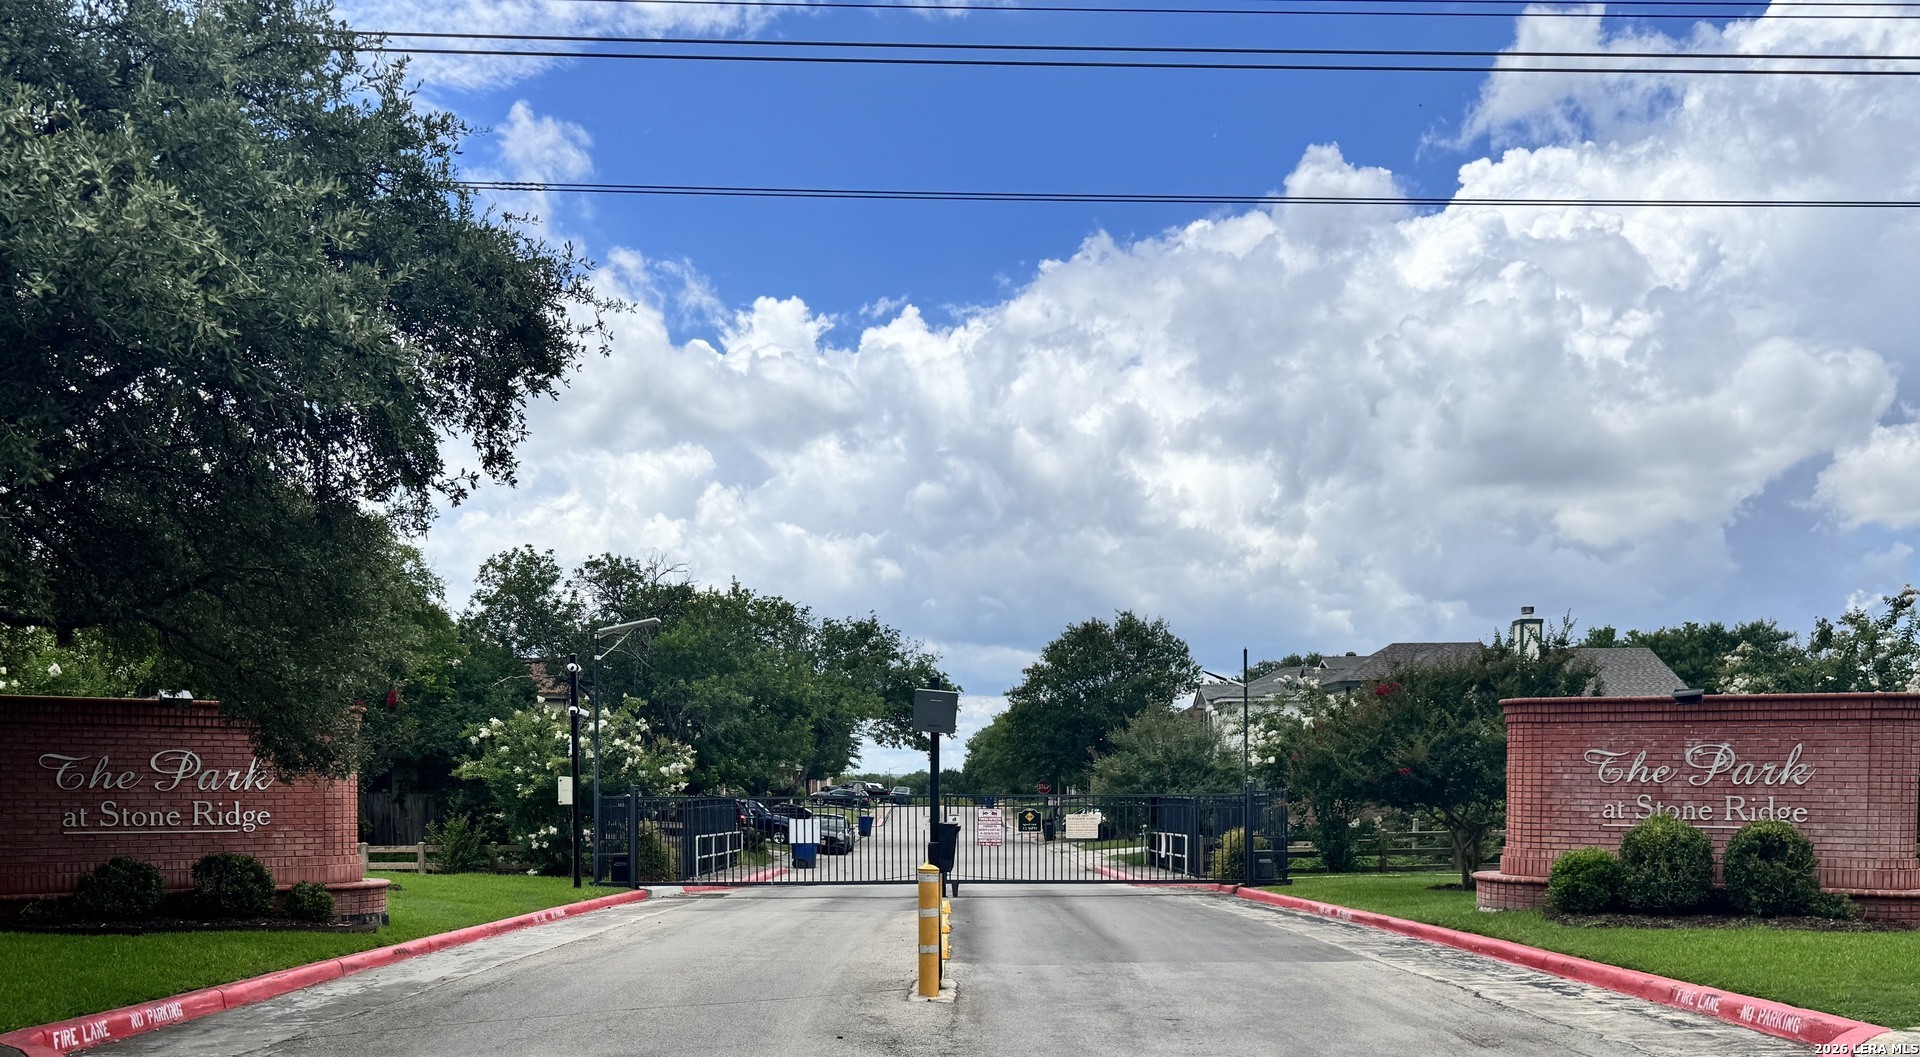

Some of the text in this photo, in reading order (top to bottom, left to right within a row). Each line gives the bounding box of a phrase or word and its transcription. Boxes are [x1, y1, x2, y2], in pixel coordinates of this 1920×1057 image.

[39, 749, 275, 792] The Park
[1584, 743, 1817, 786] The Park
[62, 801, 271, 832] at Stone Ridge
[1602, 794, 1809, 823] at Stone Ridge
[53, 1001, 184, 1050] FIRE LANE NO PARKING
[1675, 989, 1801, 1034] FIRE LANE NO PARKING
